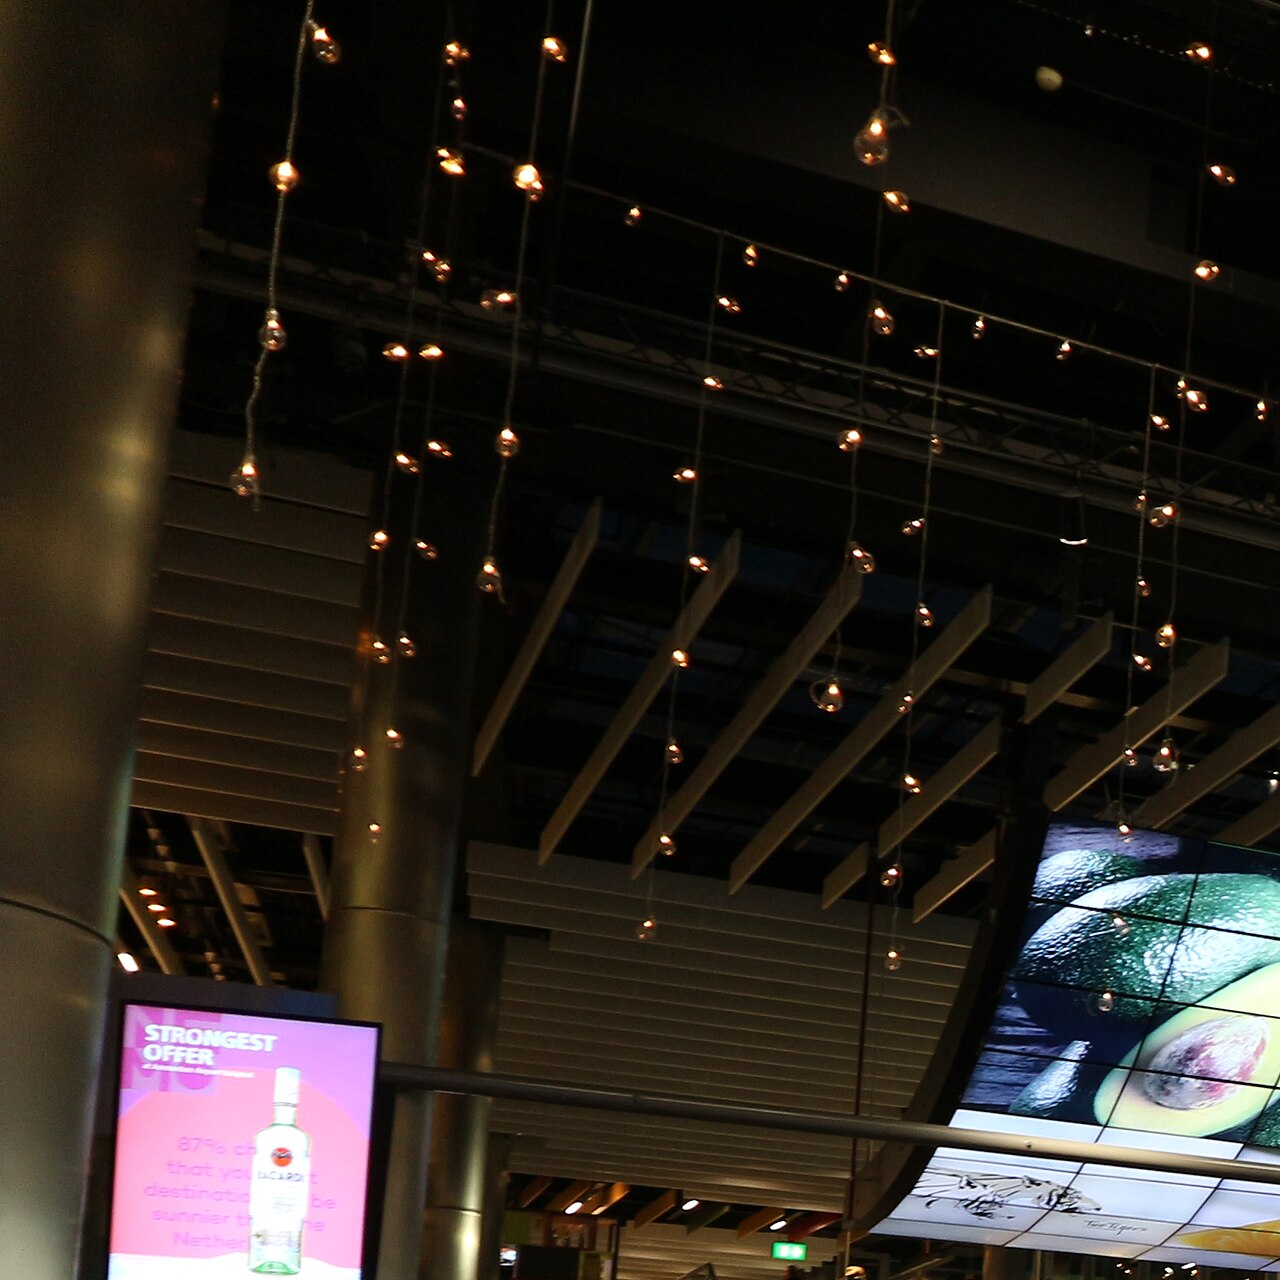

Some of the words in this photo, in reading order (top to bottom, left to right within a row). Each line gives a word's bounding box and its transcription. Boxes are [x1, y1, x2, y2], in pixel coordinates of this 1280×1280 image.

[144, 1024, 278, 1052] STRONGEST
[142, 1044, 215, 1066] OFFER
[178, 1136, 226, 1155] 87%
[166, 1161, 214, 1177] that
[220, 1165, 252, 1181] you
[143, 1184, 250, 1203] destinatio
[152, 1208, 231, 1226] sunnier
[172, 1231, 249, 1249] Nether
